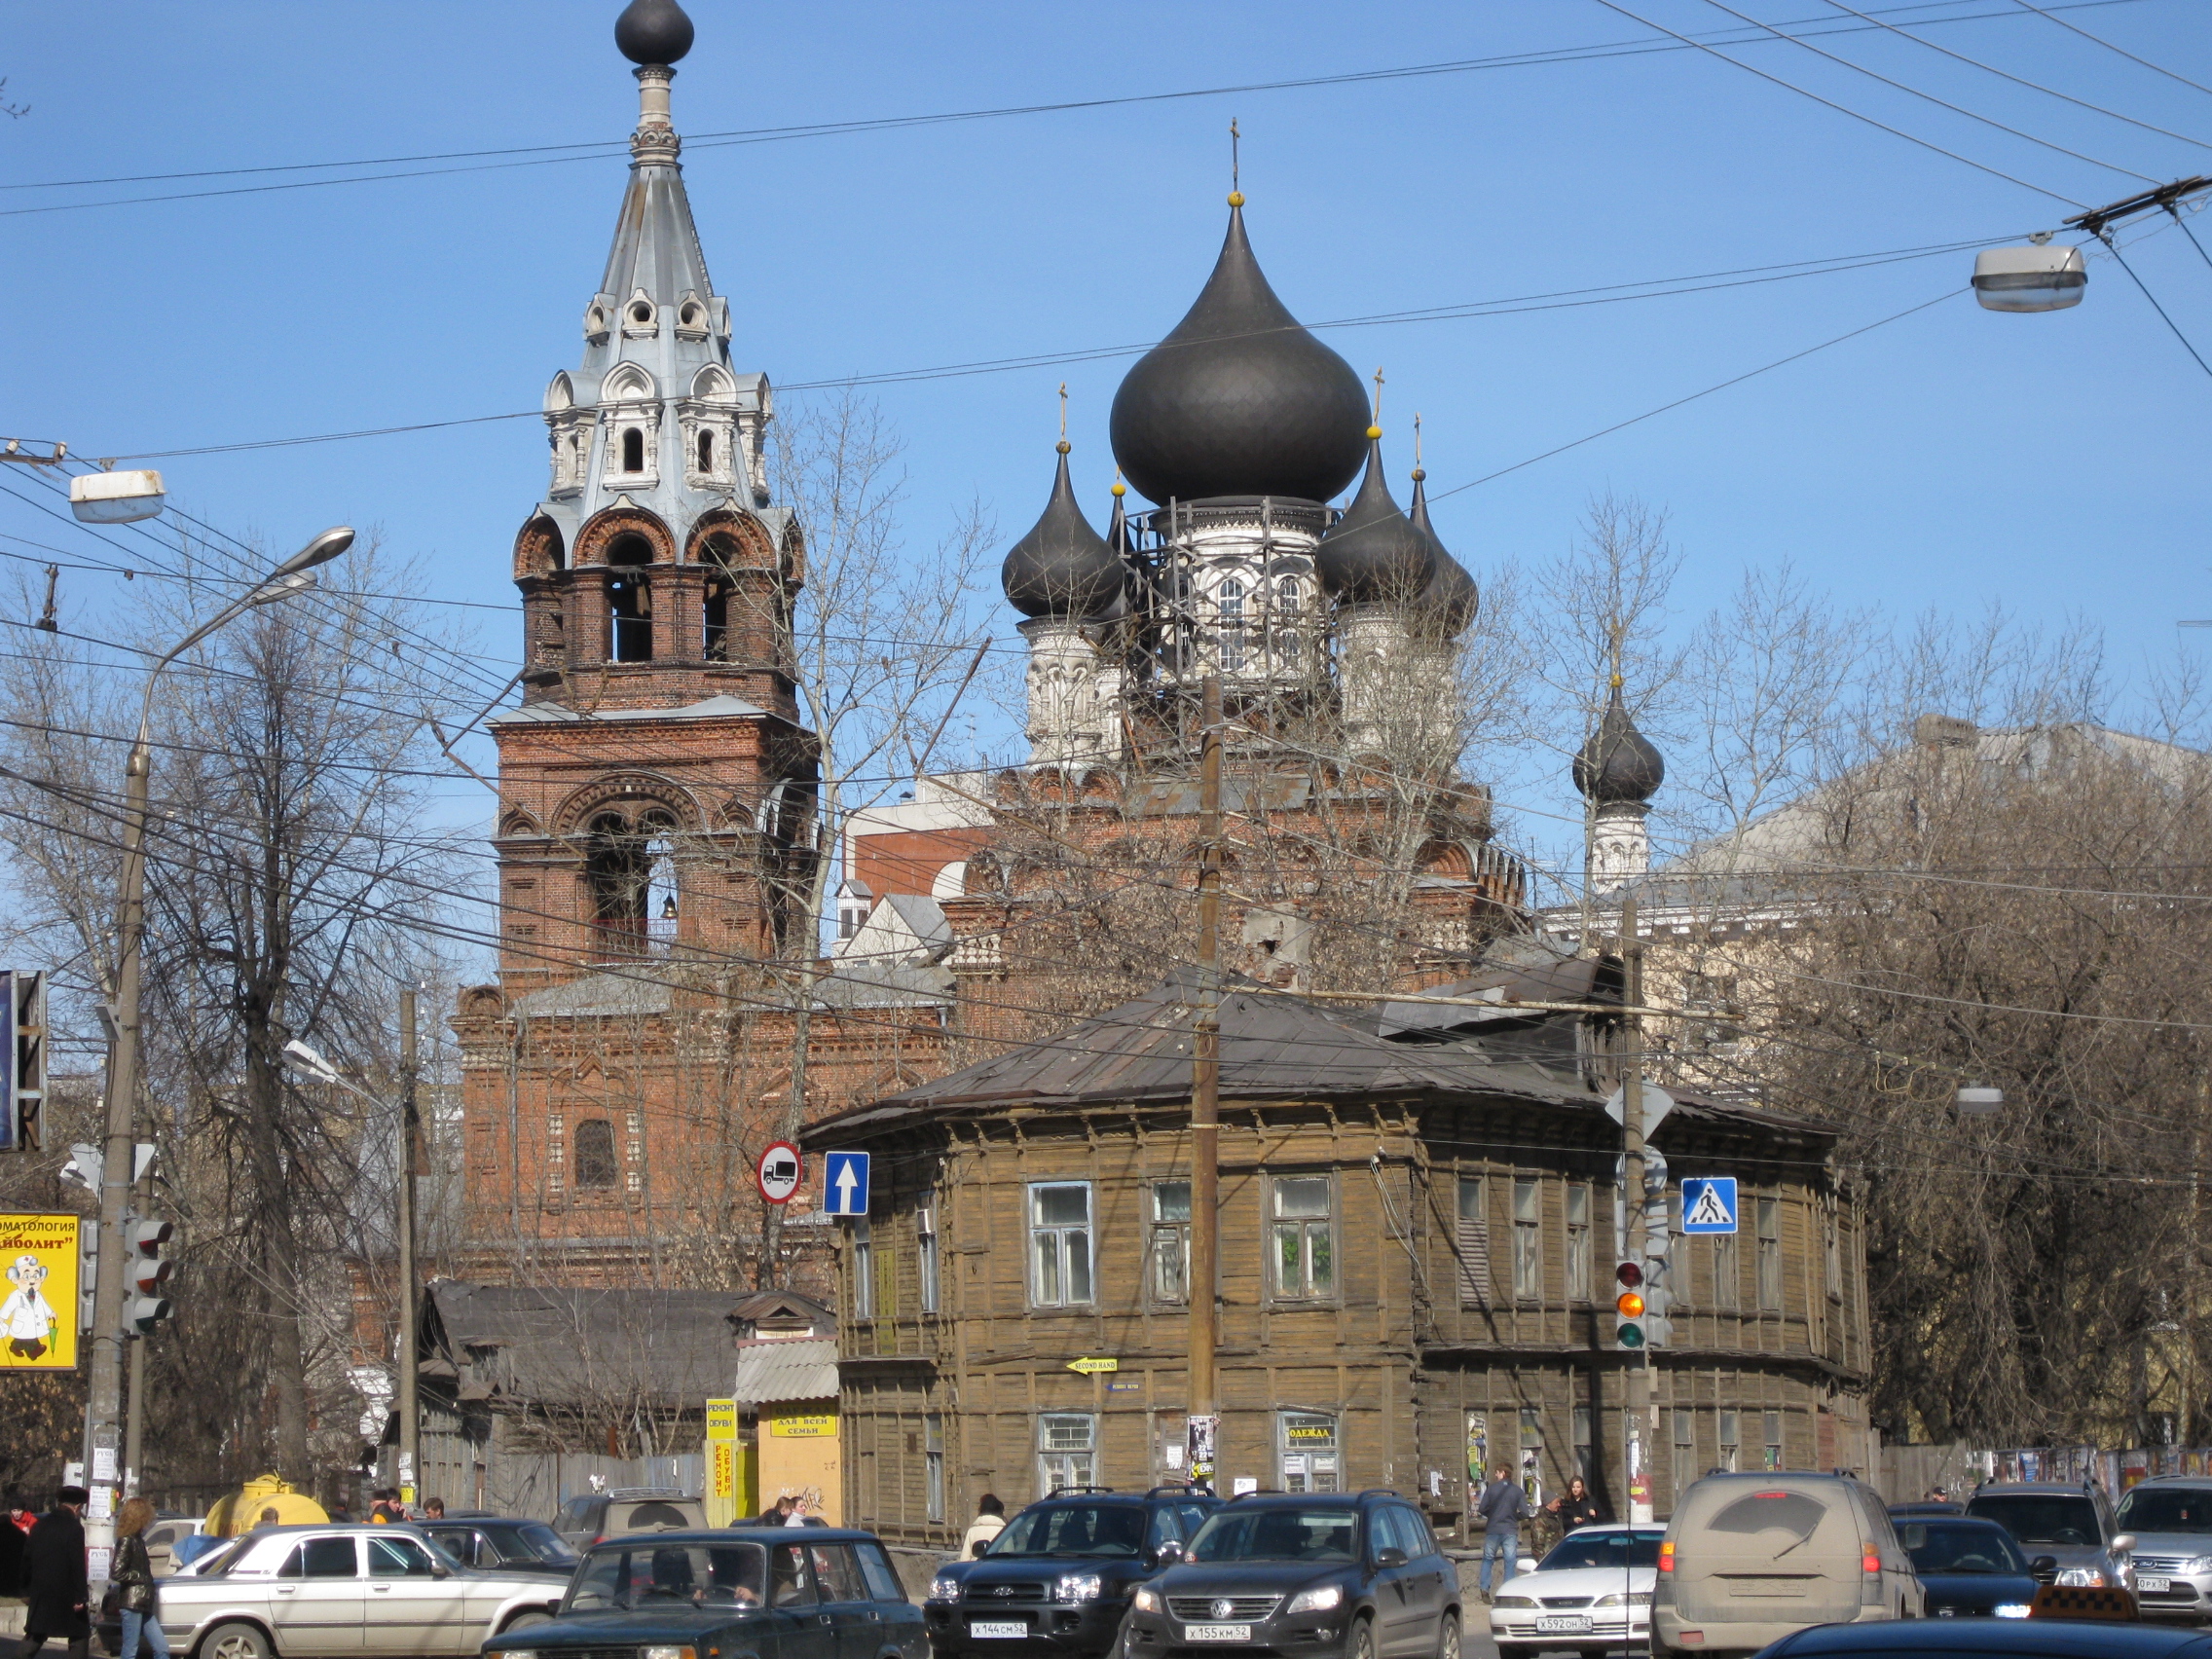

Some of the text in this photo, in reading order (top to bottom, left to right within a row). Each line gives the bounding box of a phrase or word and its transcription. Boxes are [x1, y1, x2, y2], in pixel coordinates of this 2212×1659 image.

[0, 1222, 75, 1232] МАТОЛОГИЯ
[0, 1234, 73, 1249] йболит”
[1289, 1428, 1330, 1438] ОДЕЖДА
